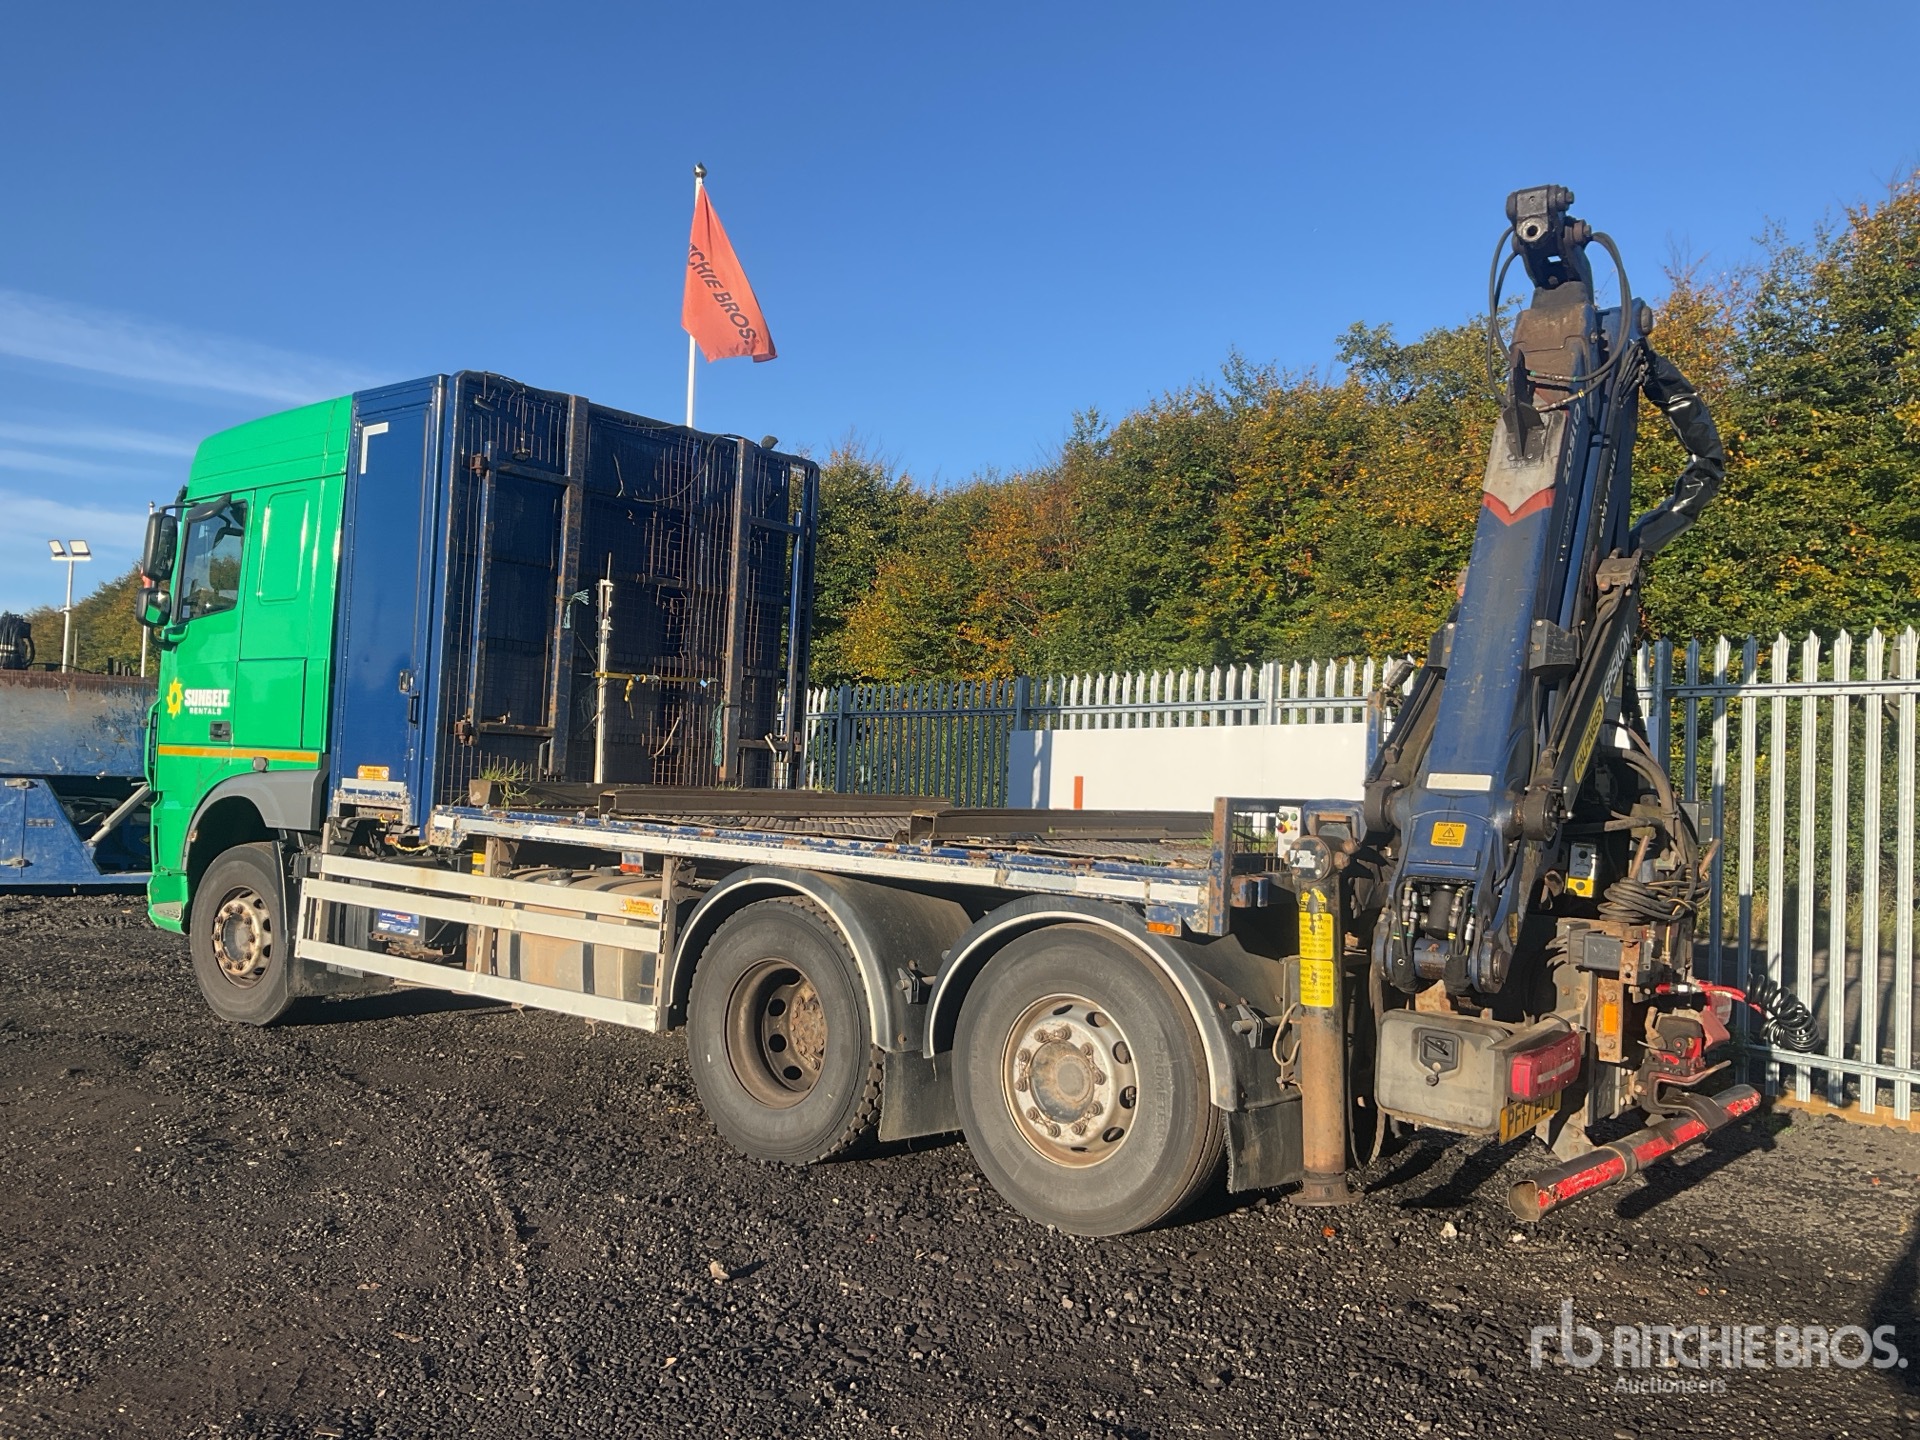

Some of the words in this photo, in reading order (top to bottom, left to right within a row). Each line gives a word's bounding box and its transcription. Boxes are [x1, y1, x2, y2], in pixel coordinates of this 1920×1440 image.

[1604, 624, 1631, 703] EPSILON
[184, 689, 231, 708] SUNBELT
[189, 707, 222, 716] RENTALS
[1575, 701, 1603, 779] PALFINGER
